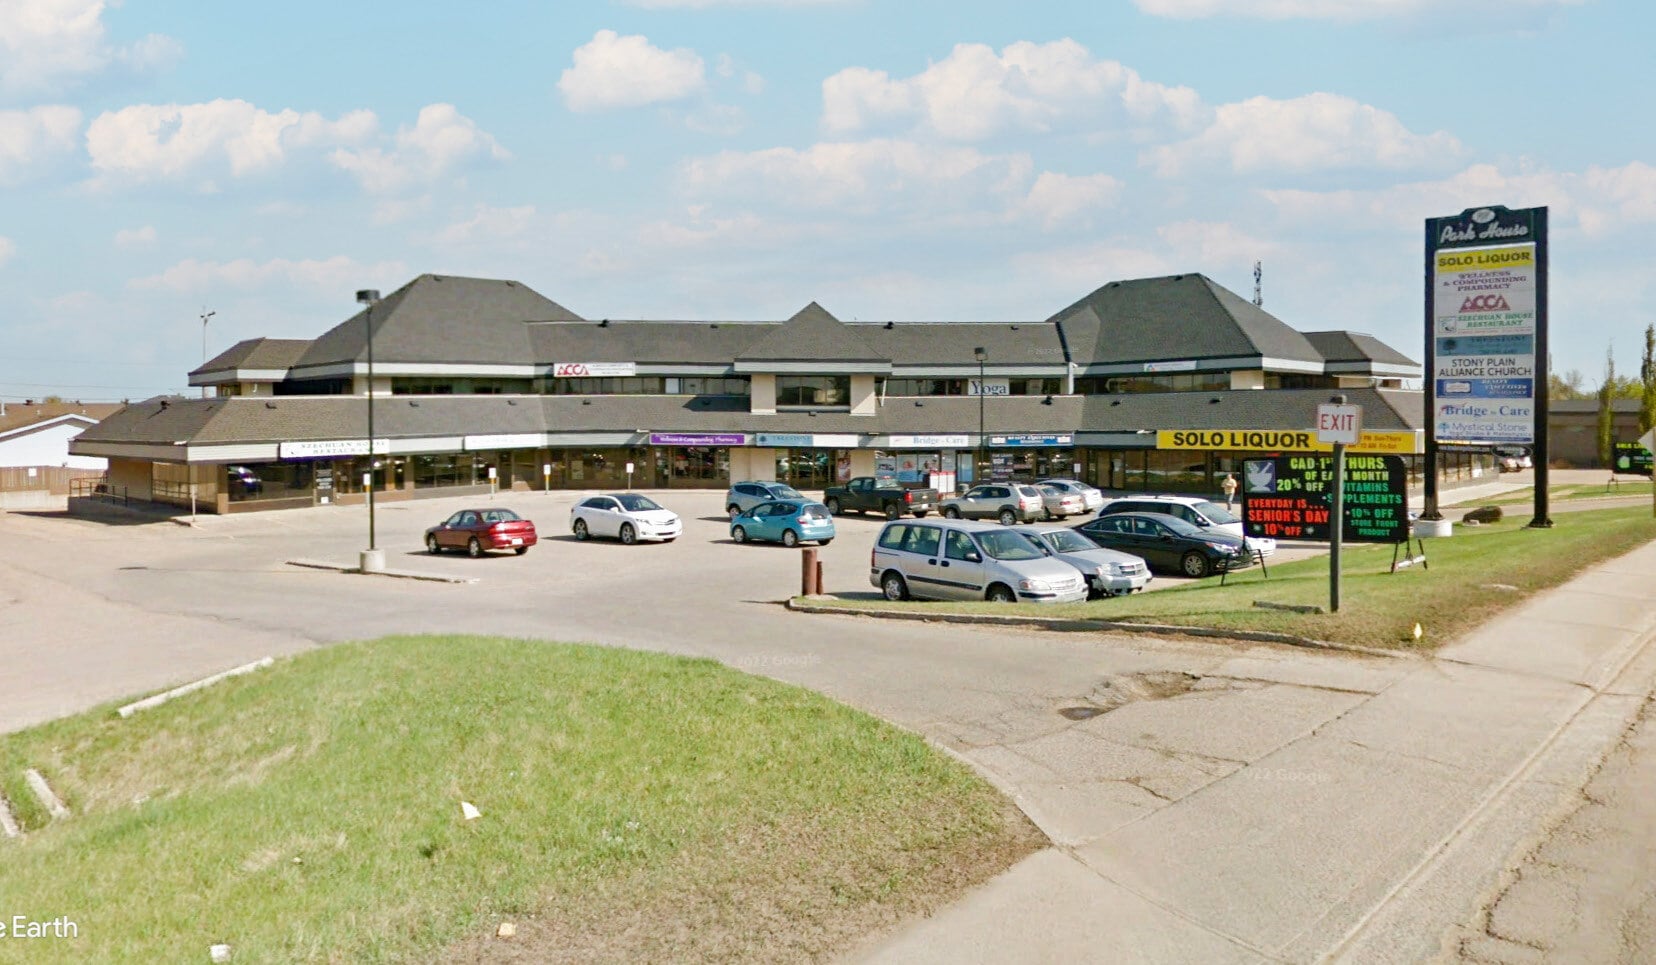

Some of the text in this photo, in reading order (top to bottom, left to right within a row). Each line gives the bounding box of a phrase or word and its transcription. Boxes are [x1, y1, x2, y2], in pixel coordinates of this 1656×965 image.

[1440, 221, 1528, 243] Park House
[1439, 252, 1530, 267] SOLO LIQUOR
[1453, 276, 1527, 286] COMPOUNDING
[1457, 283, 1511, 291] PHARMACY
[1459, 294, 1511, 313] ACCA
[1452, 358, 1515, 367] STONY PLAIN
[557, 364, 590, 375] ACCA
[1439, 367, 1531, 376] ALLIANCE CHURCH
[971, 381, 1006, 395] Yoga
[1445, 404, 1488, 417] Bridge
[1499, 405, 1530, 416] Care
[1320, 414, 1354, 430] EXIT
[1452, 423, 1495, 432] Mystical
[913, 436, 938, 445] Bridge
[1173, 432, 1310, 448] SOLO LIQUOR
[1305, 471, 1389, 481] OF EAH MONTH
[1277, 478, 1302, 491] 20%
[1306, 482, 1325, 492] OFF
[1248, 498, 1293, 508] EVERYDAY
[1327, 493, 1402, 504] SPPLEMENTS
[1248, 510, 1329, 523] SENIOR'S DAY
[1374, 508, 1393, 518] OFF
[1285, 526, 1301, 536] OFF
[1359, 528, 1390, 536] PRODUCT
